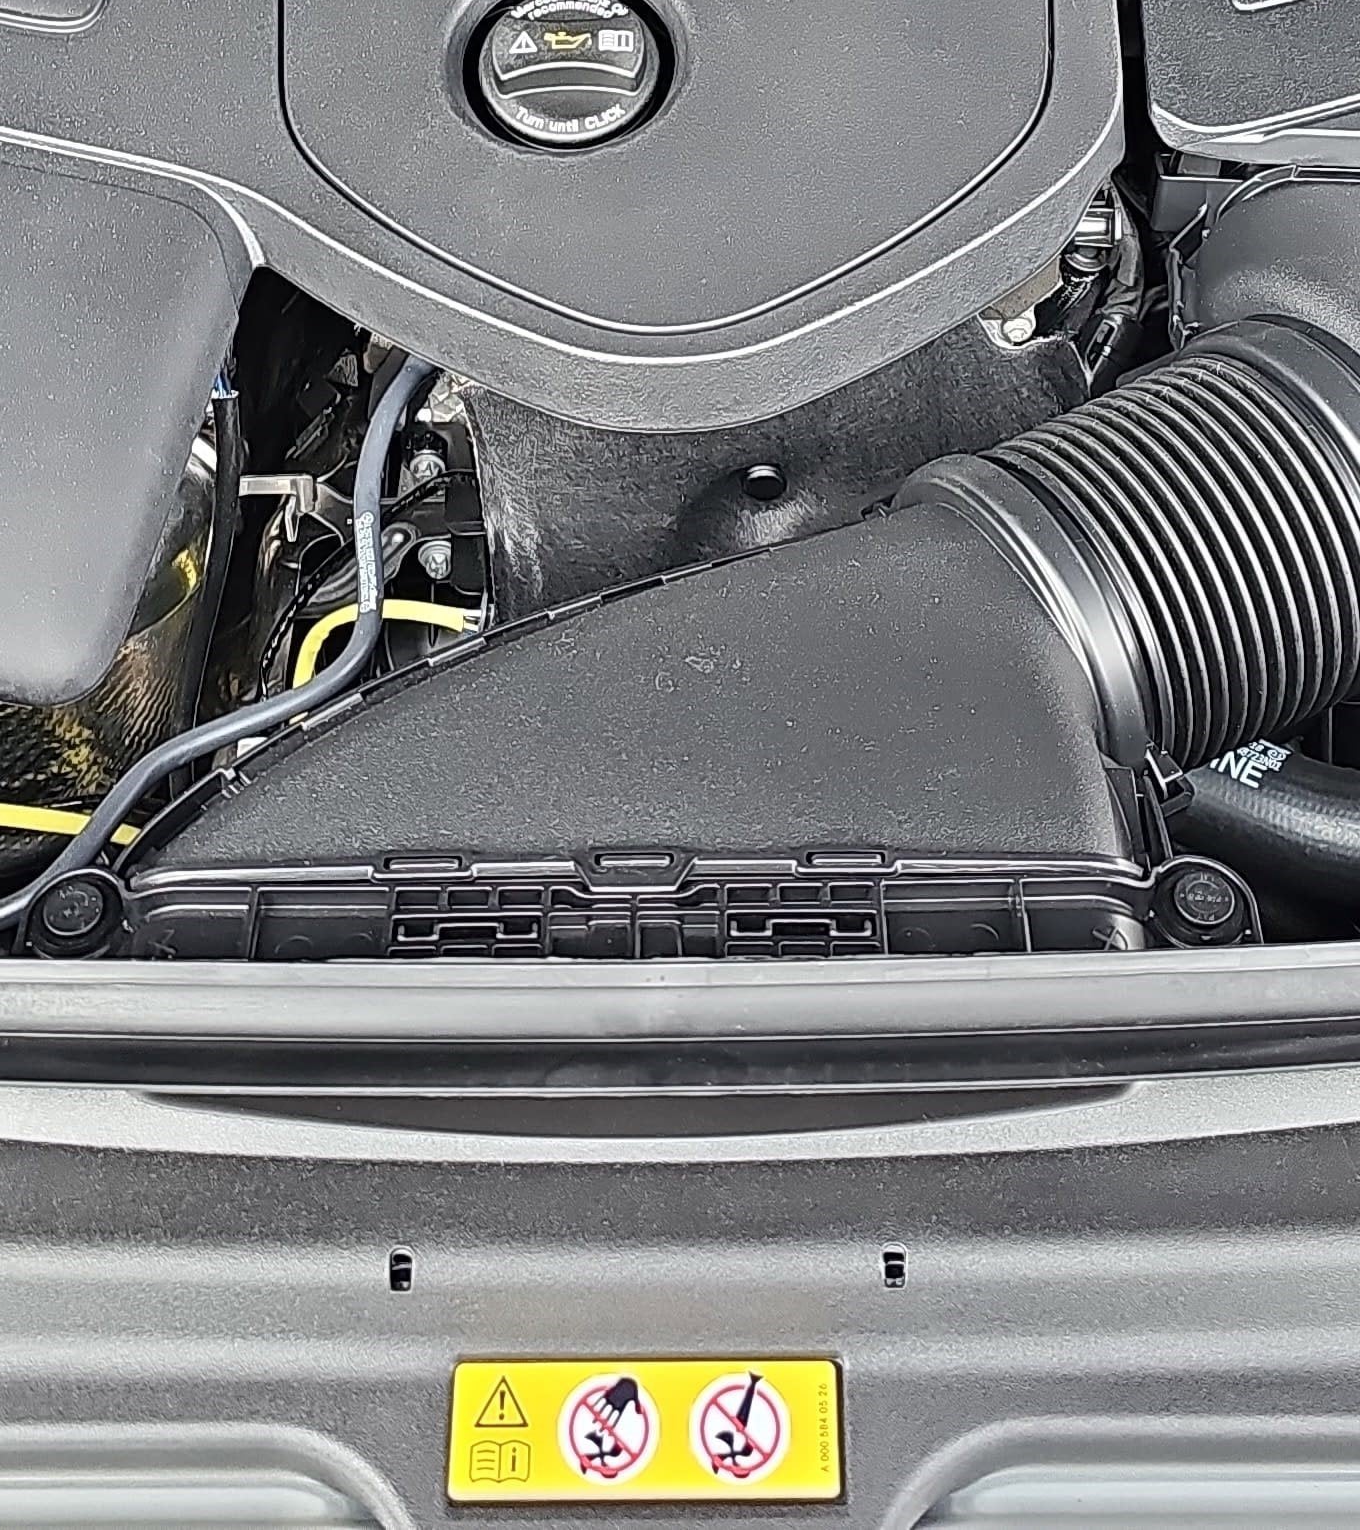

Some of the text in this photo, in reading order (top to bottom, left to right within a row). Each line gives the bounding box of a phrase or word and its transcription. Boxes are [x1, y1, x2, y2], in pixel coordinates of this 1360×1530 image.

[527, 1, 614, 21] recommended
[515, 103, 626, 132] Turn until CLICK
